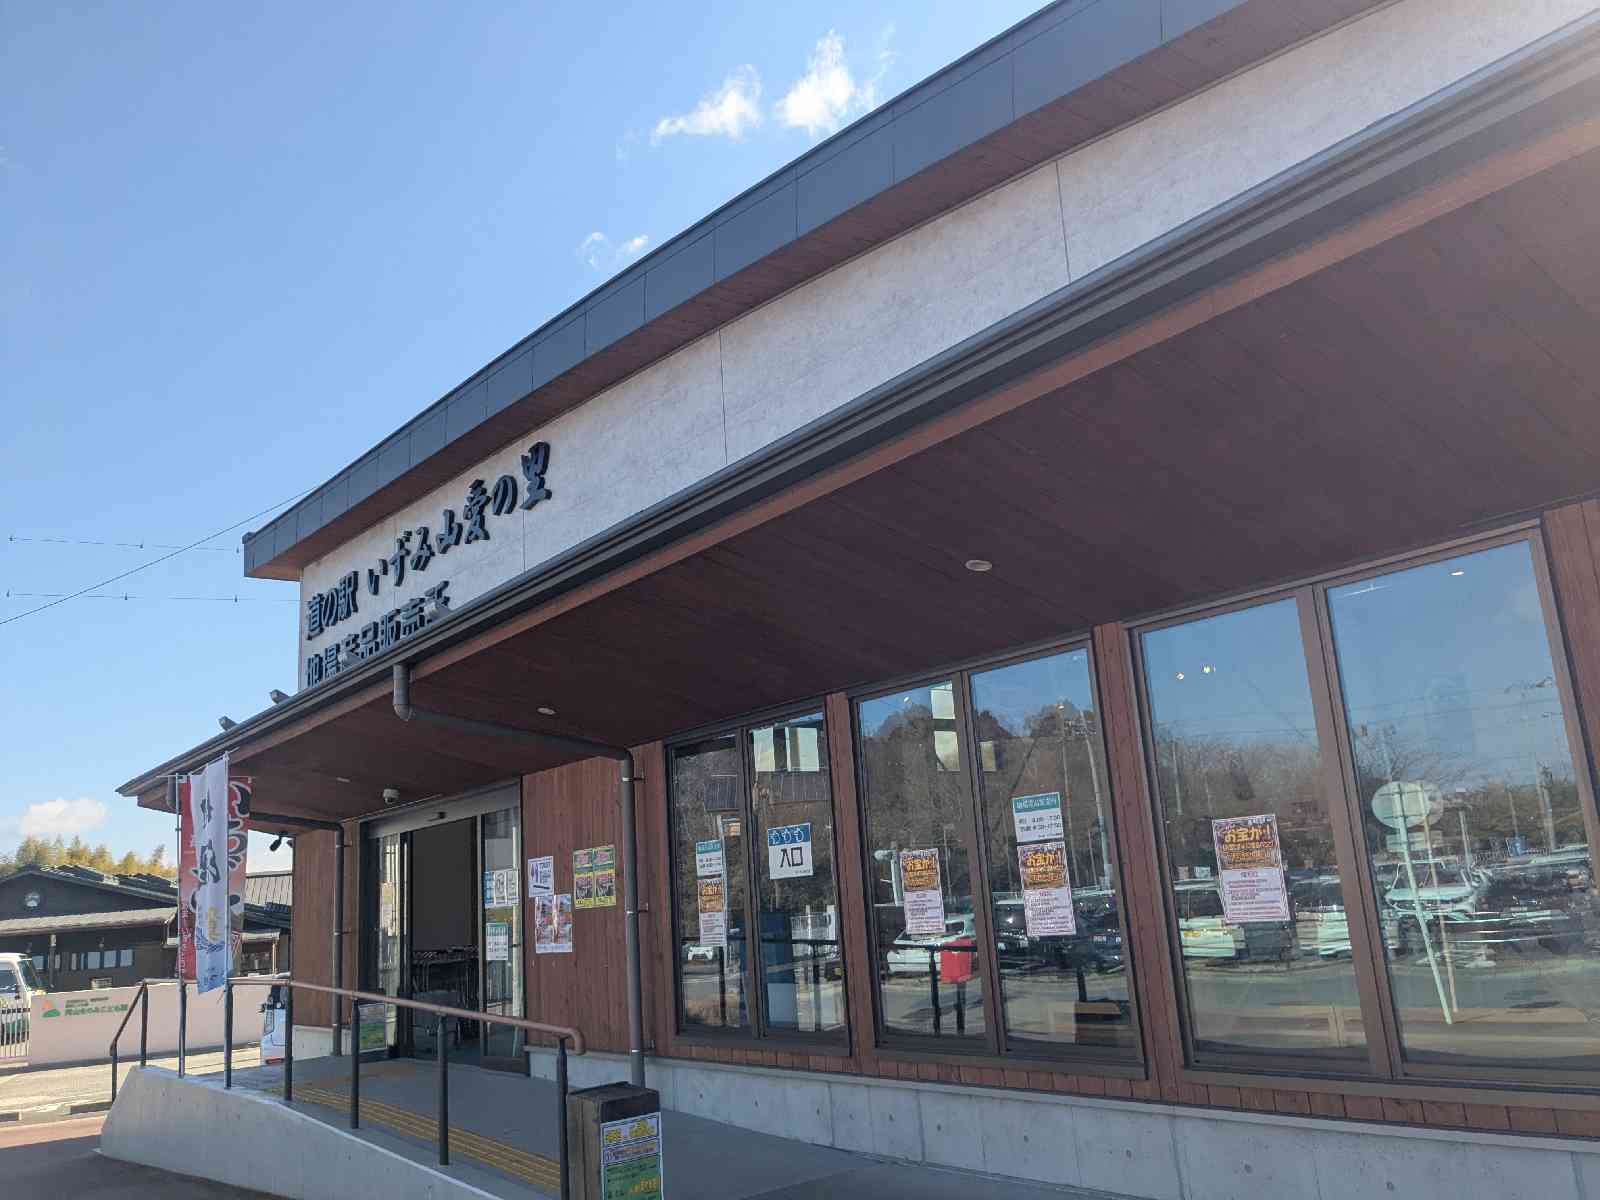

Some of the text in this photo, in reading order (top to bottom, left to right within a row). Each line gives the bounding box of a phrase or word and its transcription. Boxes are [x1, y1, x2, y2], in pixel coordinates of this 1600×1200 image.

[306, 571, 359, 641] 道の駅
[780, 846, 804, 868] 入口
